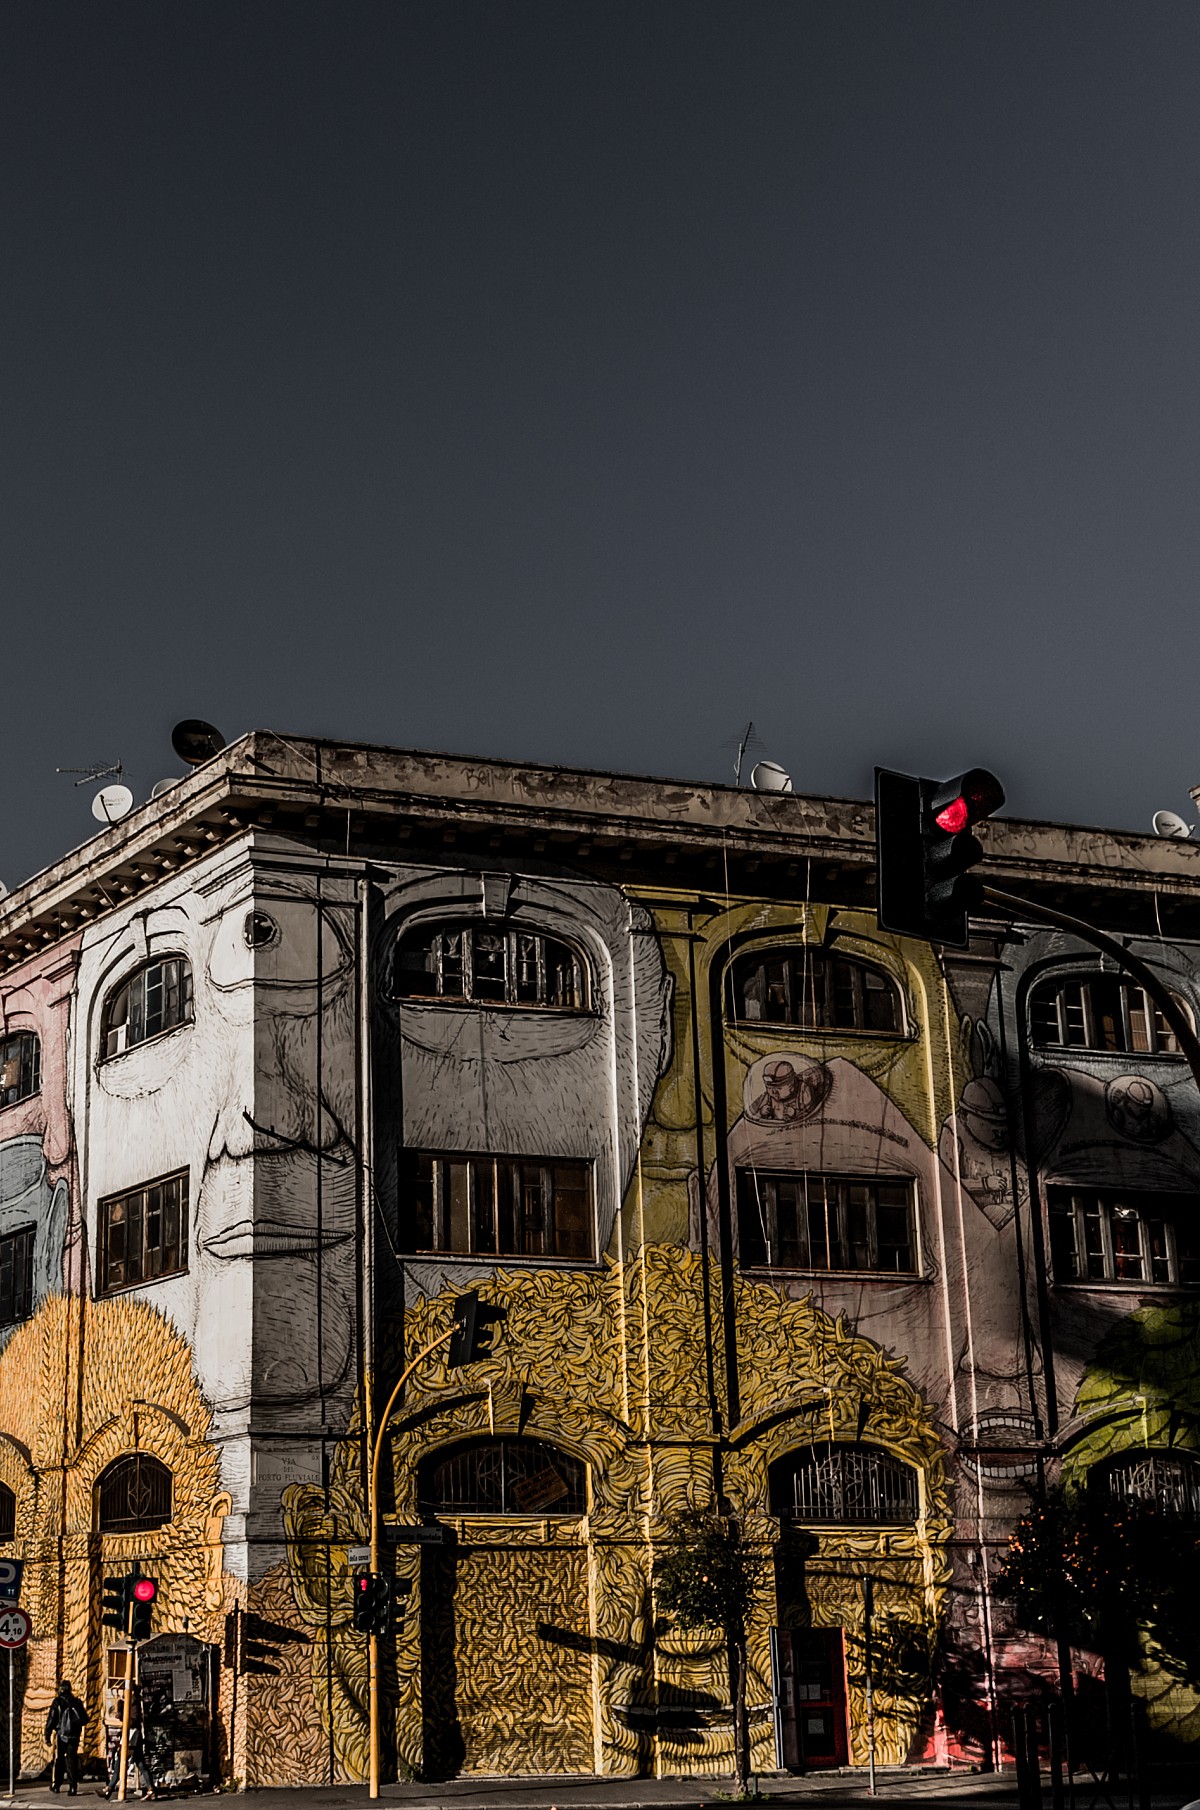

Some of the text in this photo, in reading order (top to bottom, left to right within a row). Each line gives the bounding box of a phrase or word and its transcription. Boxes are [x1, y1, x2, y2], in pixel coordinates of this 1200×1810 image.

[282, 1457, 296, 1465] VIA
[258, 1473, 320, 1482] PORTO FLUVIALE
[417, 1532, 442, 1541] fluviale
